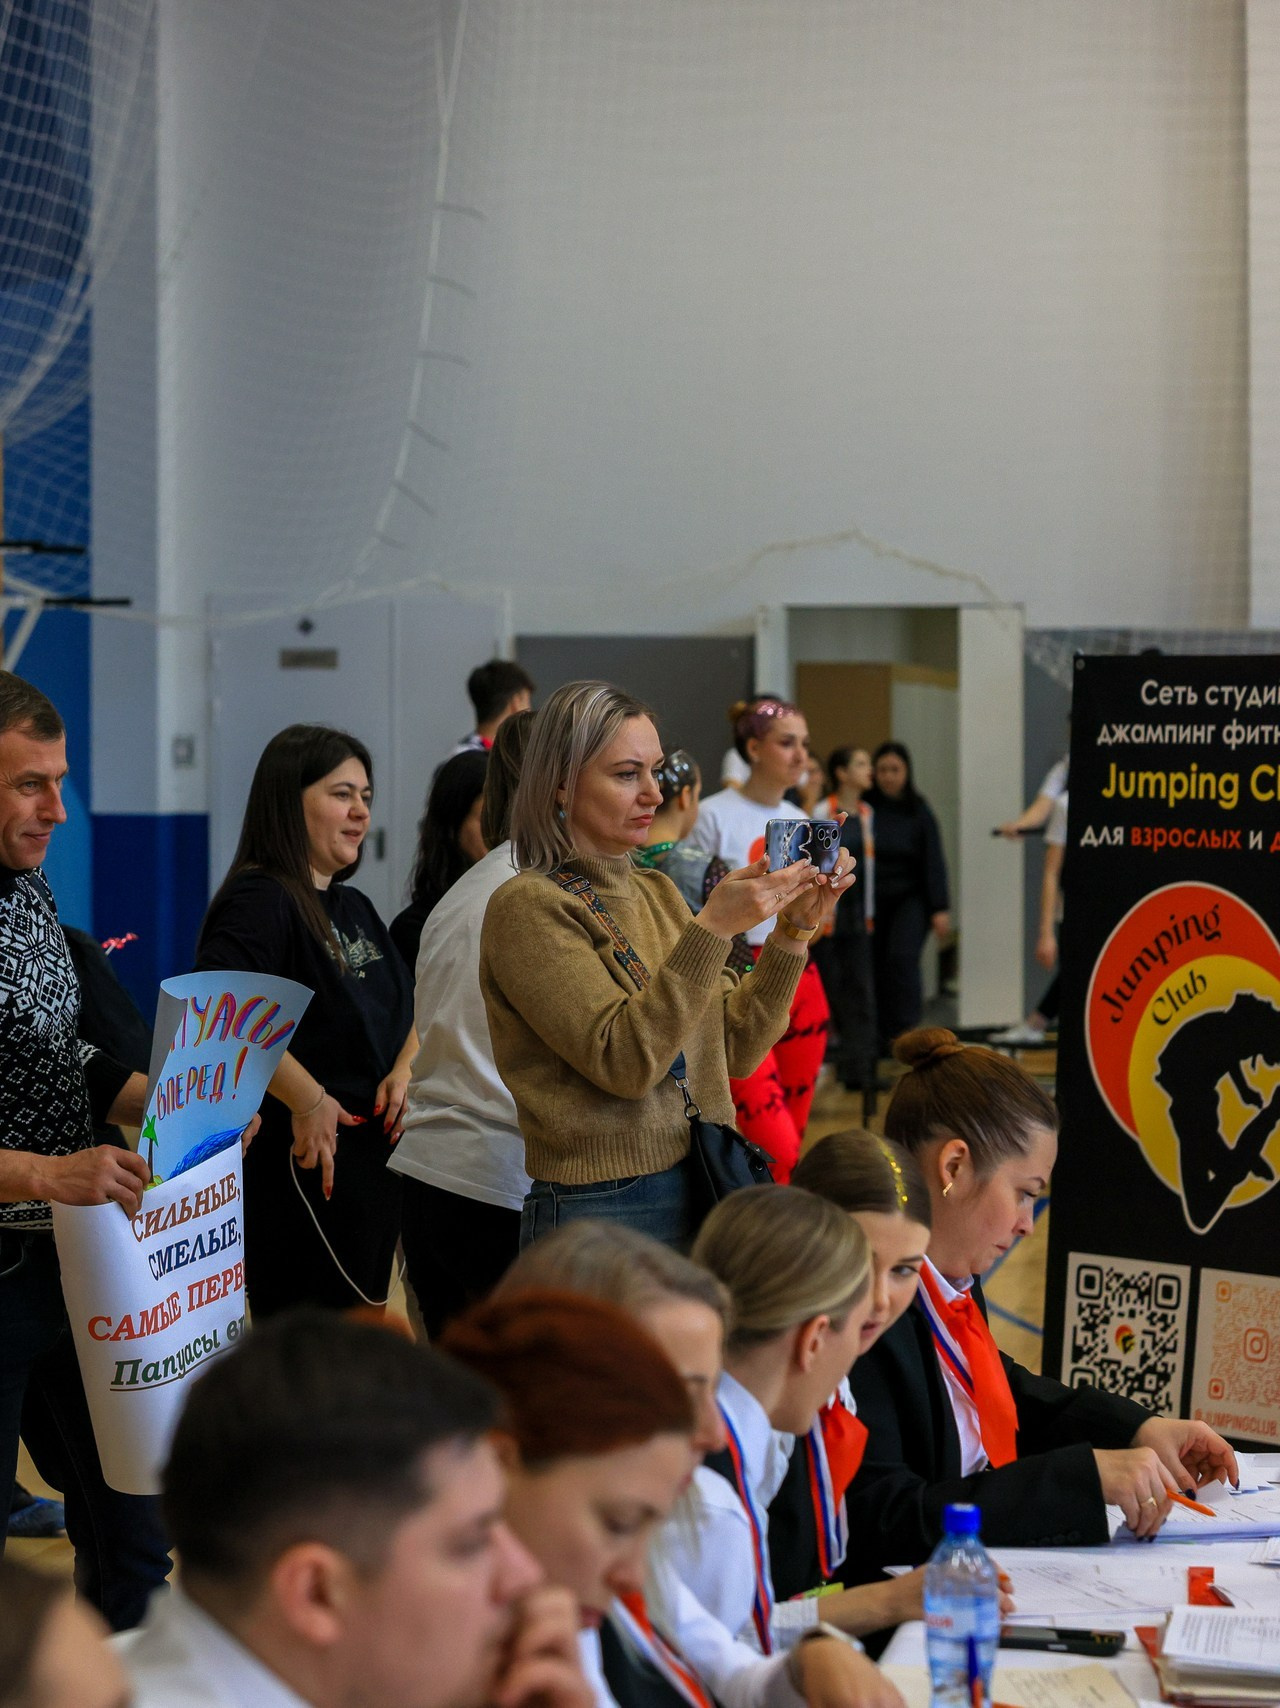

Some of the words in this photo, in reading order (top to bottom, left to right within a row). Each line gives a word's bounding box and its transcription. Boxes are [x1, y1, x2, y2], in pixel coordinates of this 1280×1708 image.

[1140, 679, 1199, 706] Сеть
[1204, 680, 1280, 712] студи
[1096, 723, 1216, 746] джампинг
[1101, 762, 1239, 810] Jumping
[1080, 825, 1124, 847] для
[1131, 826, 1242, 853] взрослых
[1249, 829, 1263, 851] и
[1101, 903, 1222, 1024] Jumping
[1152, 969, 1207, 1026] Club
[131, 1171, 241, 1243] СИЛЬНЫЕ,
[148, 1216, 242, 1281] СМЕЛЫЕ,
[87, 1291, 182, 1342] САМЫЕ
[187, 1258, 245, 1313] ПЕРВ
[110, 1328, 221, 1386] Папуасы
